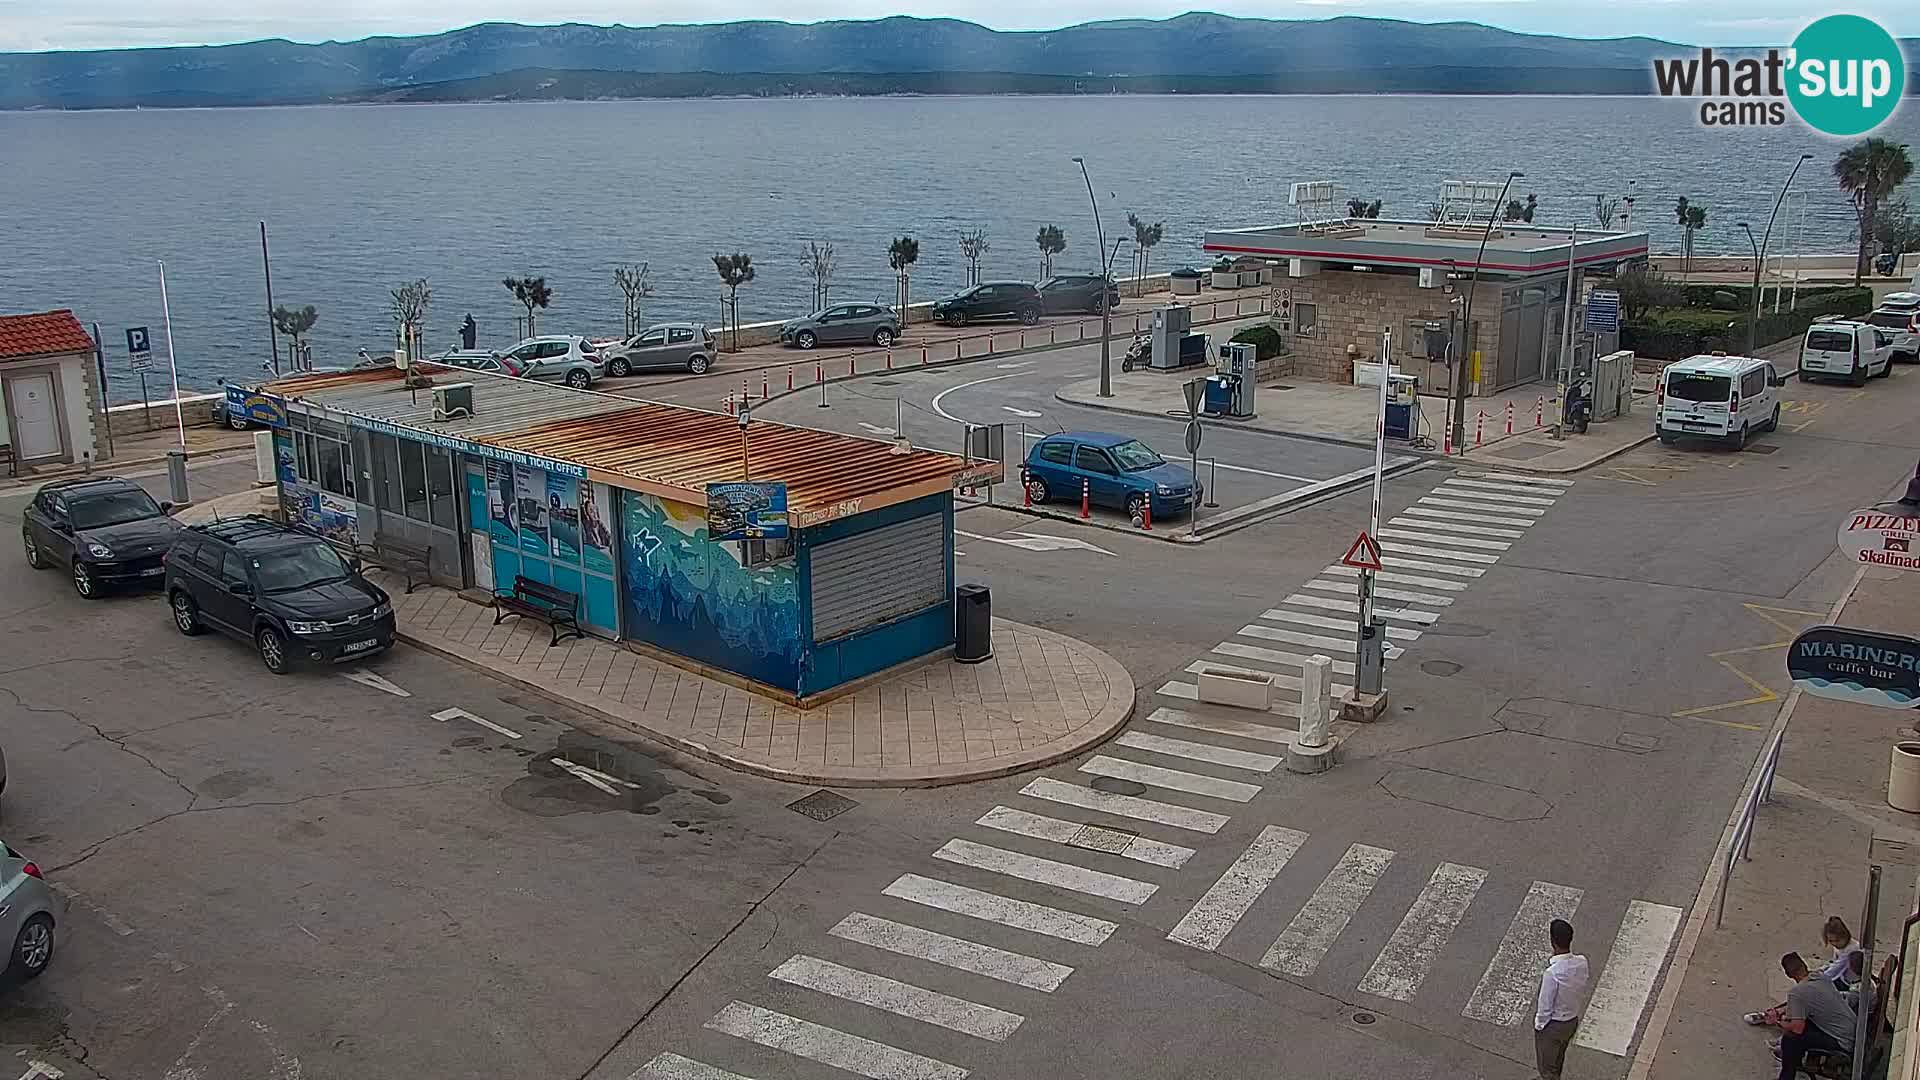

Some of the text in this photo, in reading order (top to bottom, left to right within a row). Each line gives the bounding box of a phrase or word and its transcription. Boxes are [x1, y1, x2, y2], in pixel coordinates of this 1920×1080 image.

[131, 330, 145, 349] P
[397, 426, 437, 444] AUTOBUSNA
[437, 435, 469, 451] POSTAJA
[479, 445, 584, 477] BUS STATION TICKET OFFICE
[1881, 530, 1917, 541] GRILL
[1828, 662, 1896, 680] caffe bar
